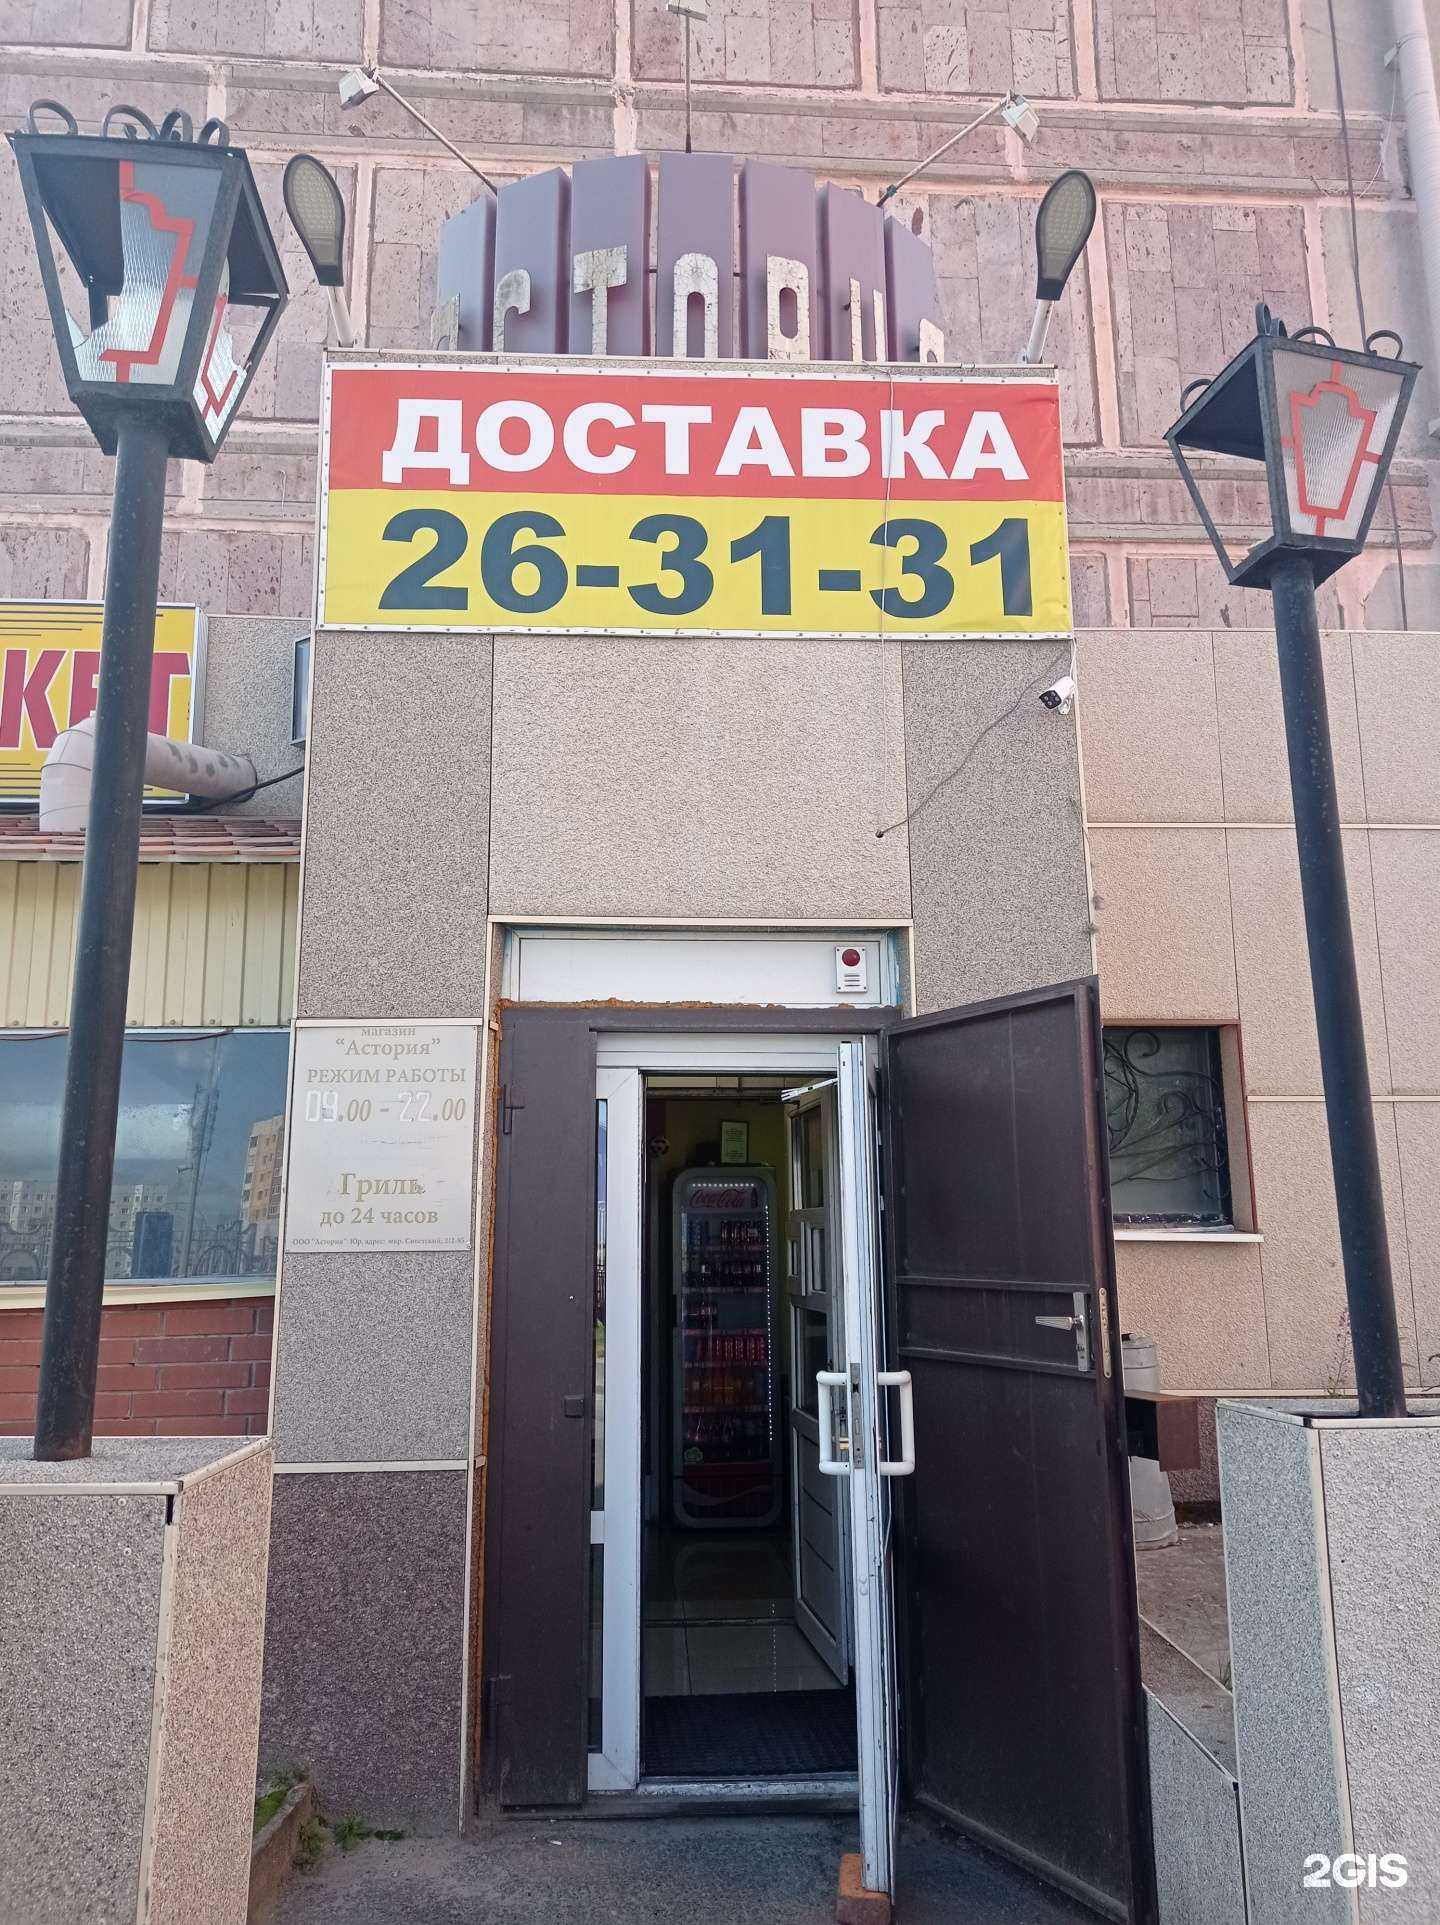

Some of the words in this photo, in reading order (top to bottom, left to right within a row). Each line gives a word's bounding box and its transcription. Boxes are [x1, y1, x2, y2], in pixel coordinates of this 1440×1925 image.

[380, 397, 1030, 485] ДОСТАВКА
[377, 508, 1034, 619] 26-31-31
[361, 1027, 416, 1037] магазин
[307, 1068, 380, 1083] РЕЖИМ
[386, 1068, 466, 1083] РАБОТЫ
[399, 1091, 466, 1122] 22.00
[339, 1173, 426, 1202] Гриль
[320, 1210, 344, 1227] до
[352, 1208, 375, 1224] 24
[381, 1208, 438, 1224] часов
